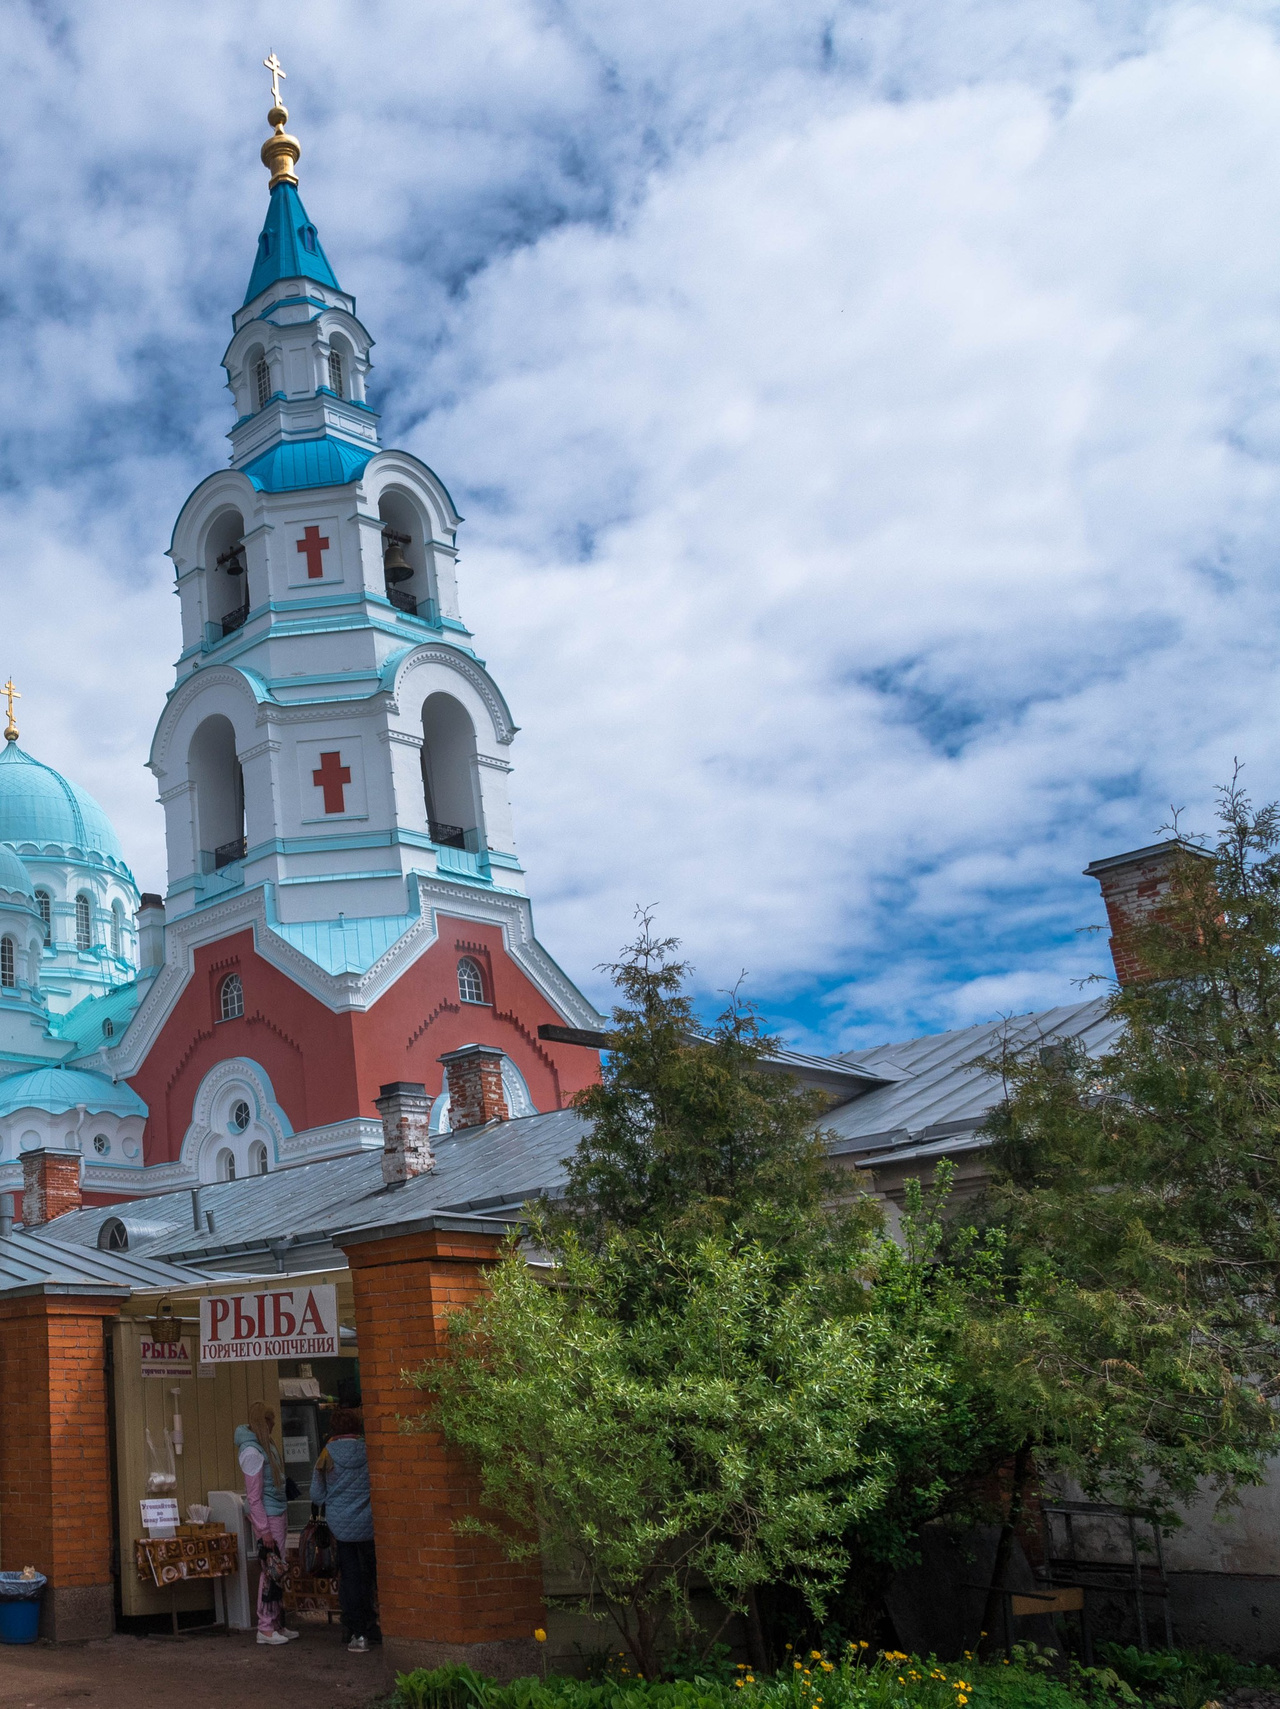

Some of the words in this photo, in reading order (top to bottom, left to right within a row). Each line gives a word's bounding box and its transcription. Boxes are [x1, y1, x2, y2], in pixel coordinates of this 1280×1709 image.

[207, 1288, 328, 1342] РЫБА
[141, 1342, 189, 1359] РЫБА
[202, 1341, 262, 1359] ГОРЯЧЕГО
[264, 1337, 335, 1356] КОПЧЕНИЯ
[142, 1368, 166, 1376] горячего
